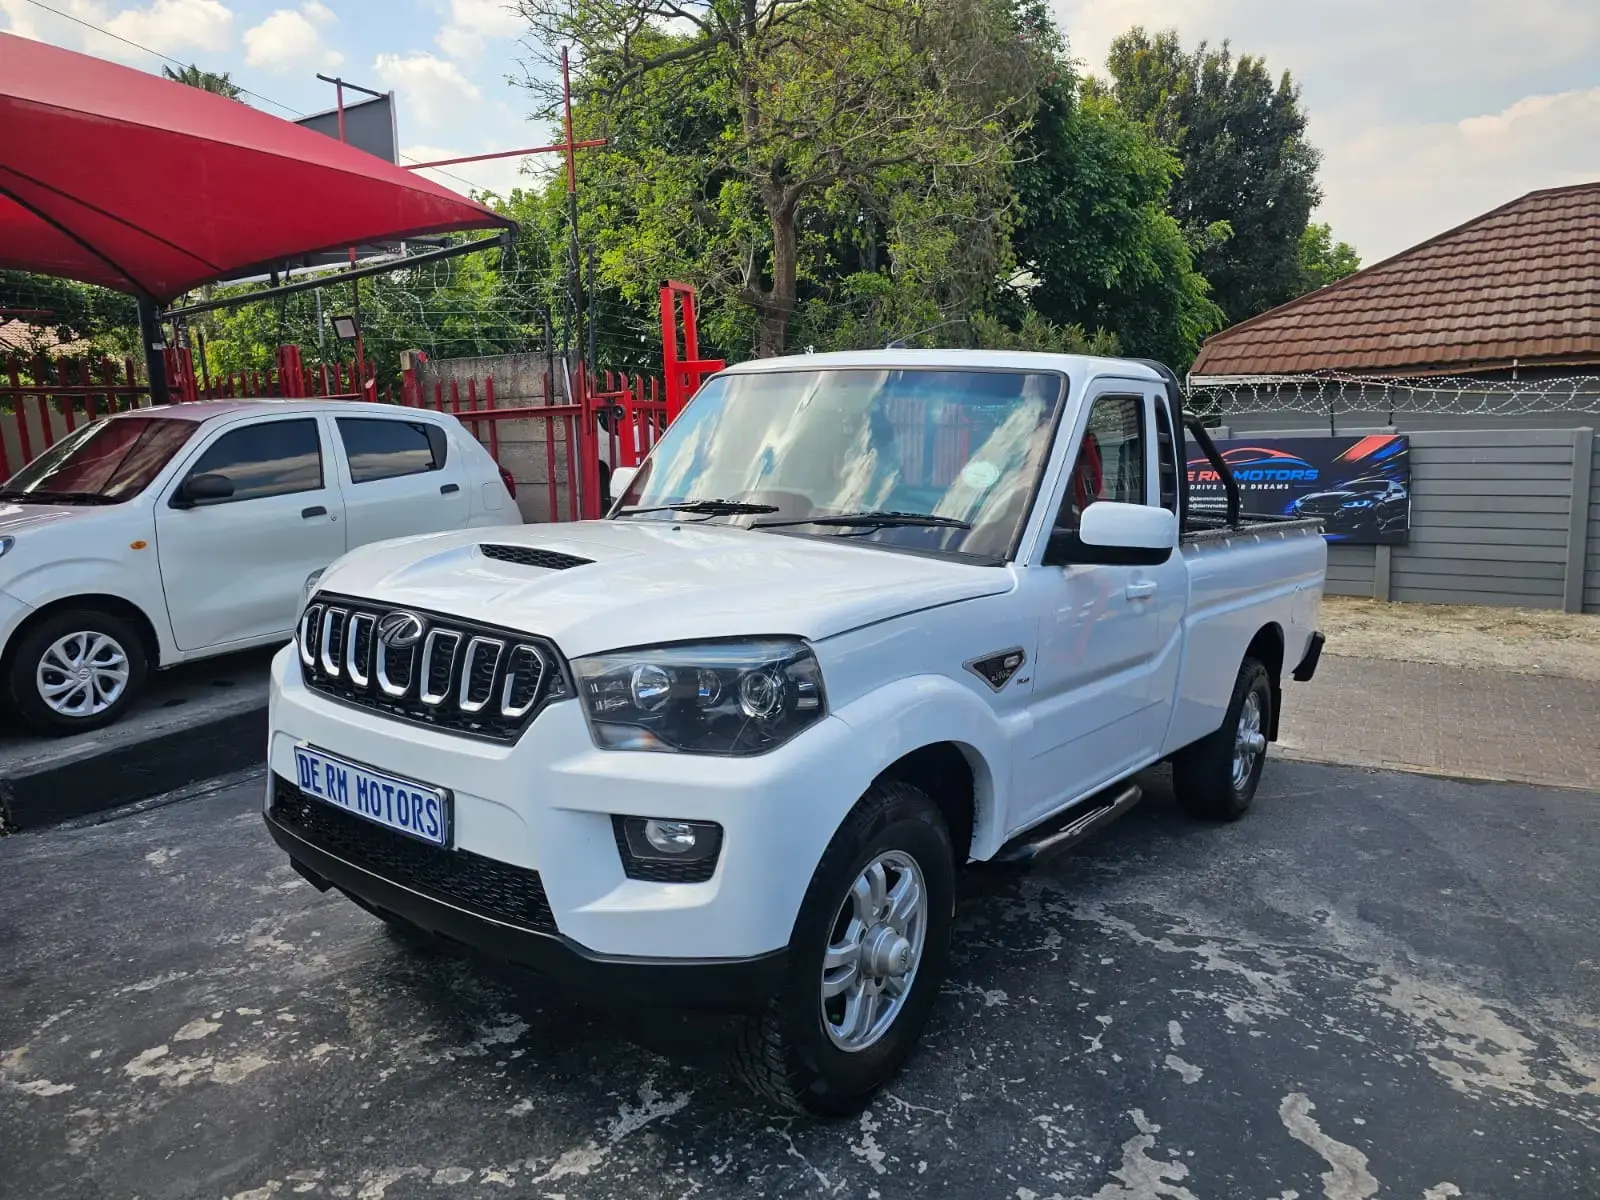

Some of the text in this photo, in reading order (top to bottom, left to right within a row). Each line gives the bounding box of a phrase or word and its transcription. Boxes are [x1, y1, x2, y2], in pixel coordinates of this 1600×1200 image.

[1233, 469, 1319, 481] MOTORS
[298, 753, 439, 837] DE RM MOTORS
